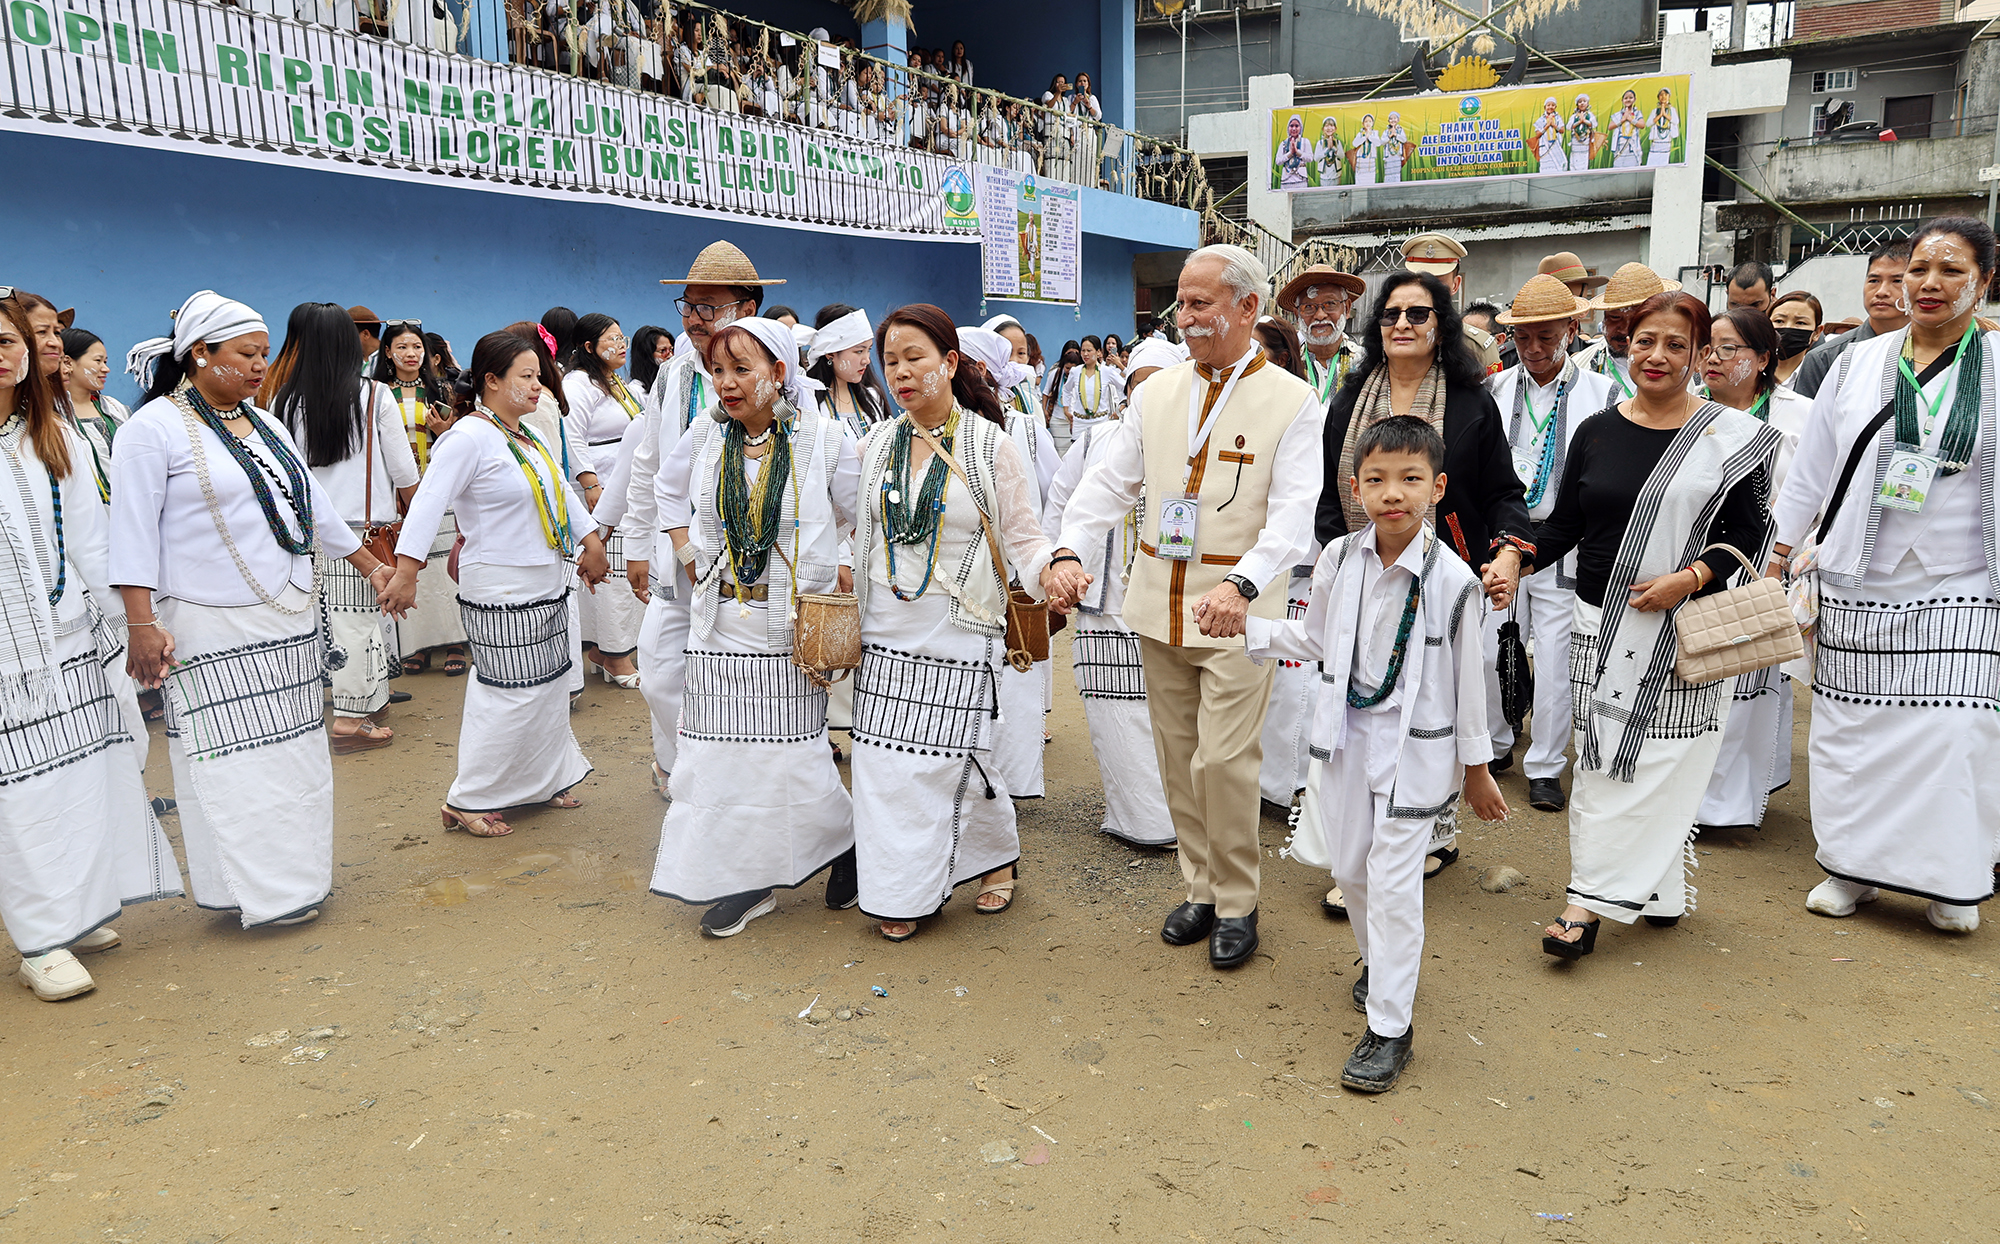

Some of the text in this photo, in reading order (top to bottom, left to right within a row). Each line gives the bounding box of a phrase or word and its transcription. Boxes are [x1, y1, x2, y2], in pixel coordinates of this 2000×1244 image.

[217, 44, 374, 108] RIPIN
[405, 78, 551, 131] NAGLA
[574, 104, 622, 138] JU
[644, 114, 700, 150] ASI
[718, 126, 790, 163] ABIR
[807, 142, 884, 181] AKUM
[895, 161, 923, 190] TO
[1440, 119, 1500, 134] THANK YOU
[1421, 129, 1519, 145] ALE BE INTO KULA KA
[291, 105, 796, 196] LOSI LOREK BUME LAJU
[1419, 140, 1523, 156] YILI BONGO LALE KULA
[1437, 152, 1502, 166] INTO KU LAKA
[1446, 163, 1488, 172] CELEBRATION
[1490, 161, 1527, 169] COMMITTEE
[1023, 290, 1035, 298] 2024
